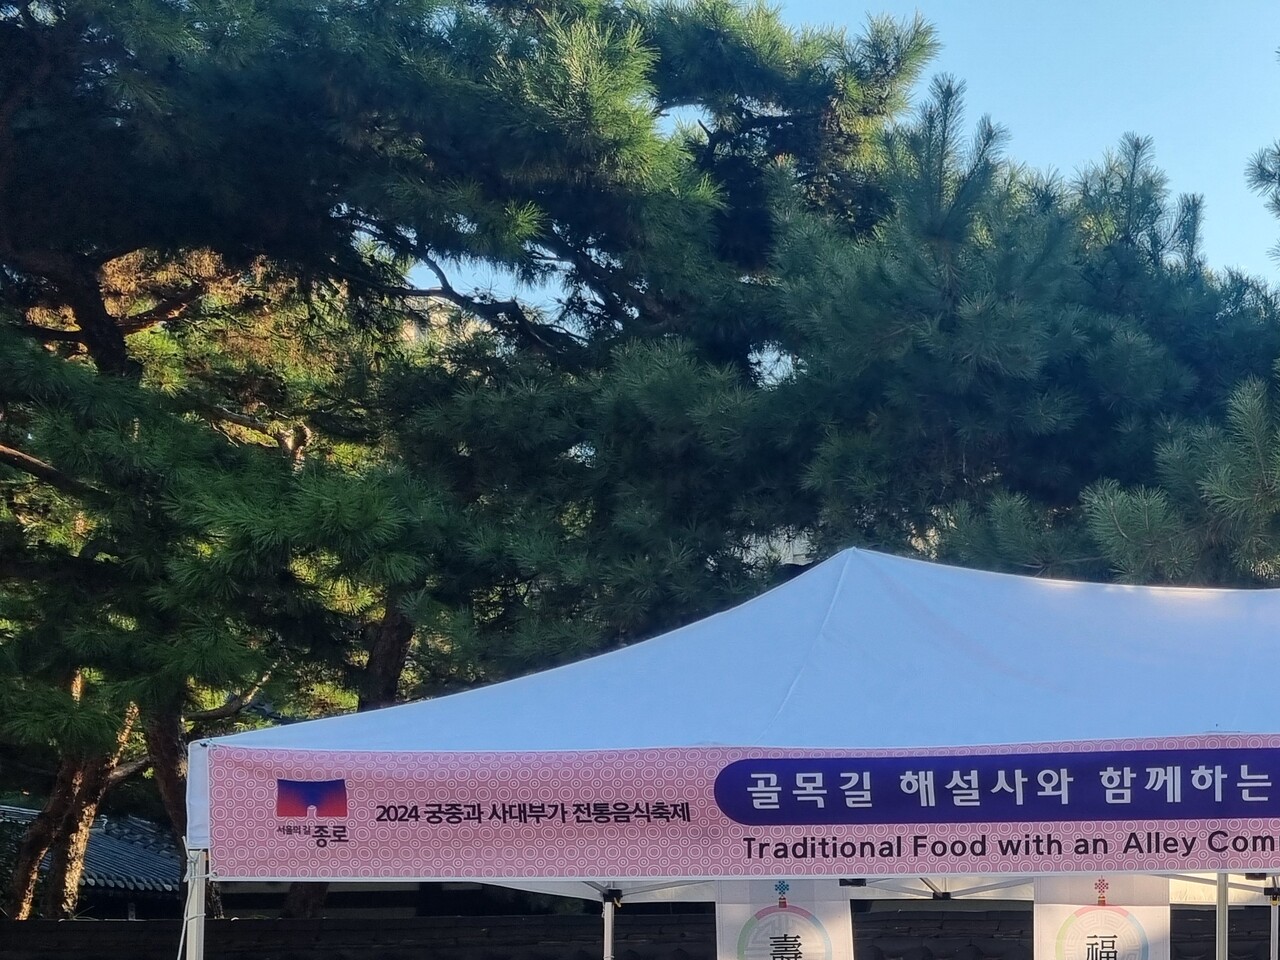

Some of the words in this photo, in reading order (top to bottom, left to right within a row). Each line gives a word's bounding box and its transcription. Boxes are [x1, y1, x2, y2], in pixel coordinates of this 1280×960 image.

[746, 771, 873, 810] 골목길
[899, 768, 1074, 807] 해설사와
[1099, 764, 1272, 804] 함께하는
[376, 805, 420, 822] 2024
[424, 803, 482, 824] 궁중과
[488, 802, 568, 824] 사대부가
[572, 802, 691, 823] 전통음식축제
[312, 825, 349, 847] 종로
[743, 835, 900, 858] Traditional
[913, 834, 987, 857] Food
[998, 833, 1063, 856] with
[1074, 838, 1108, 855] an
[1123, 832, 1197, 857] Alley
